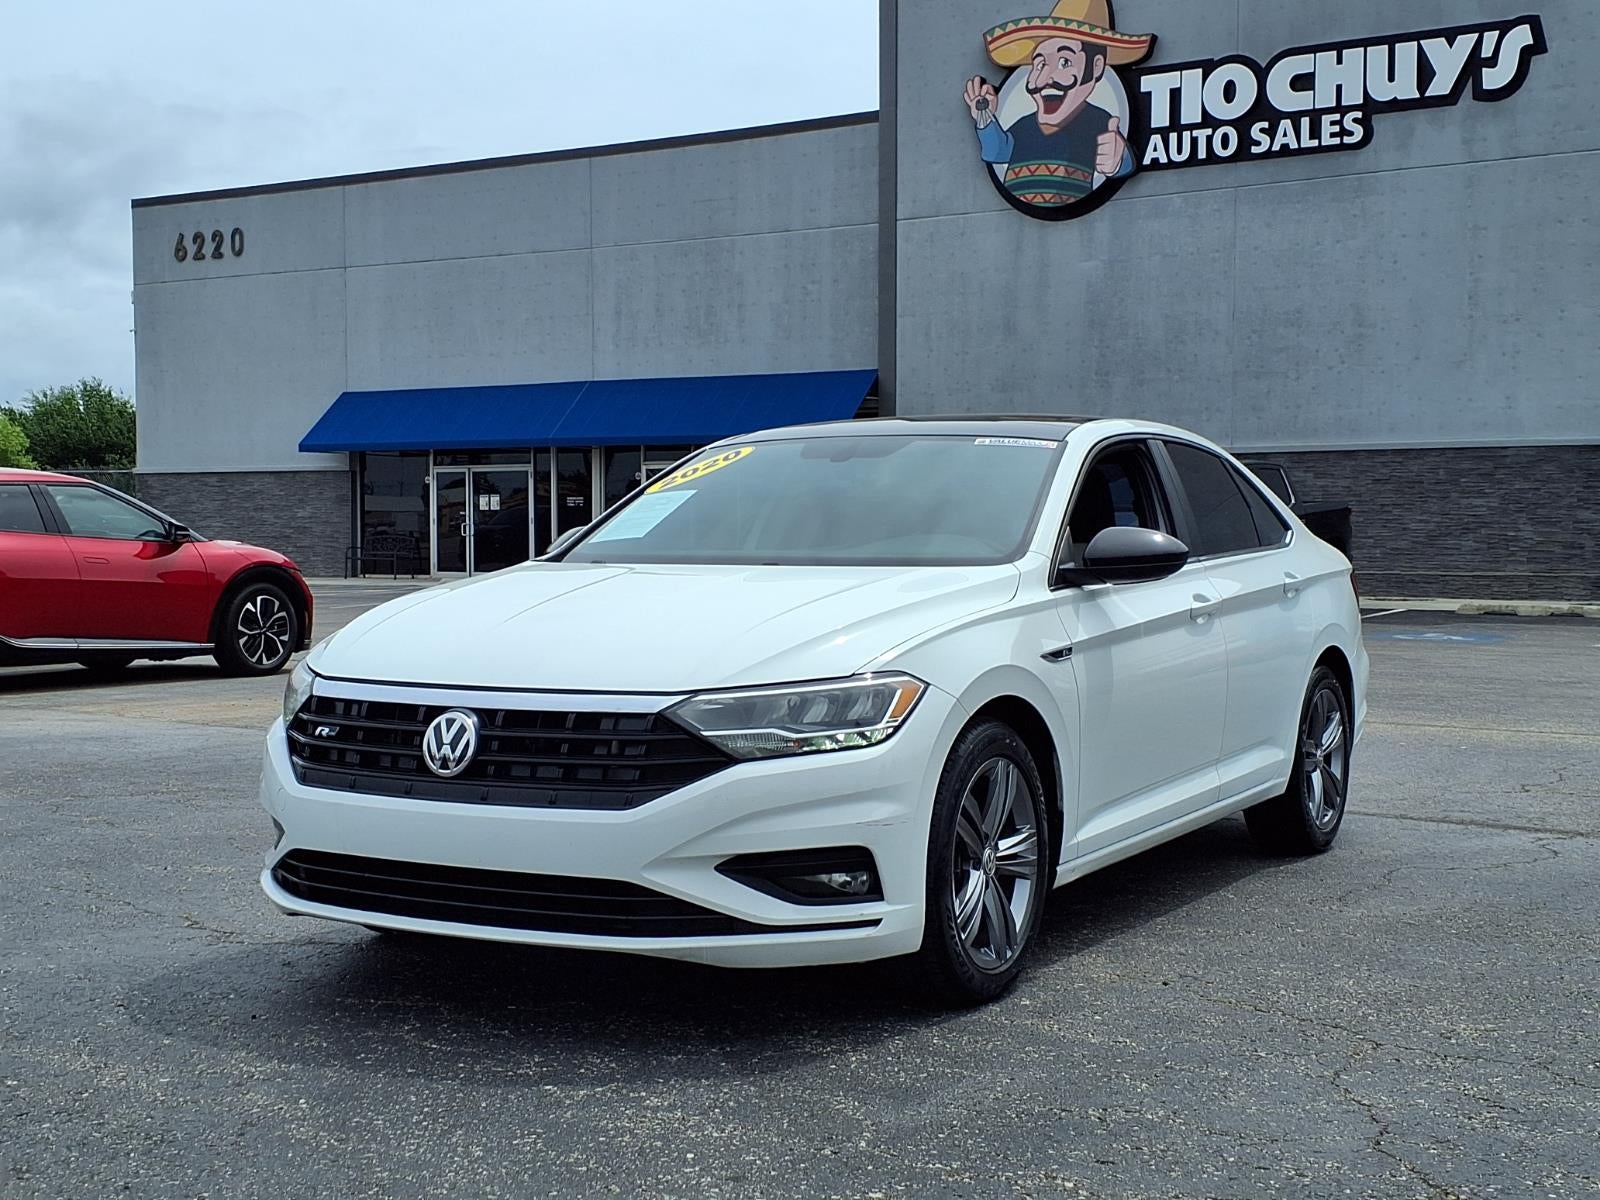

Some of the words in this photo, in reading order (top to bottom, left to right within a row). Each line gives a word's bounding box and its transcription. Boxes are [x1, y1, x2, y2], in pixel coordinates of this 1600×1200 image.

[1139, 66, 1258, 129] TIO
[1265, 24, 1534, 113] CHUY'S
[1142, 126, 1239, 166] AUTO
[1250, 111, 1365, 155] SALES
[174, 227, 245, 263] 6220
[658, 450, 742, 490] 2020
